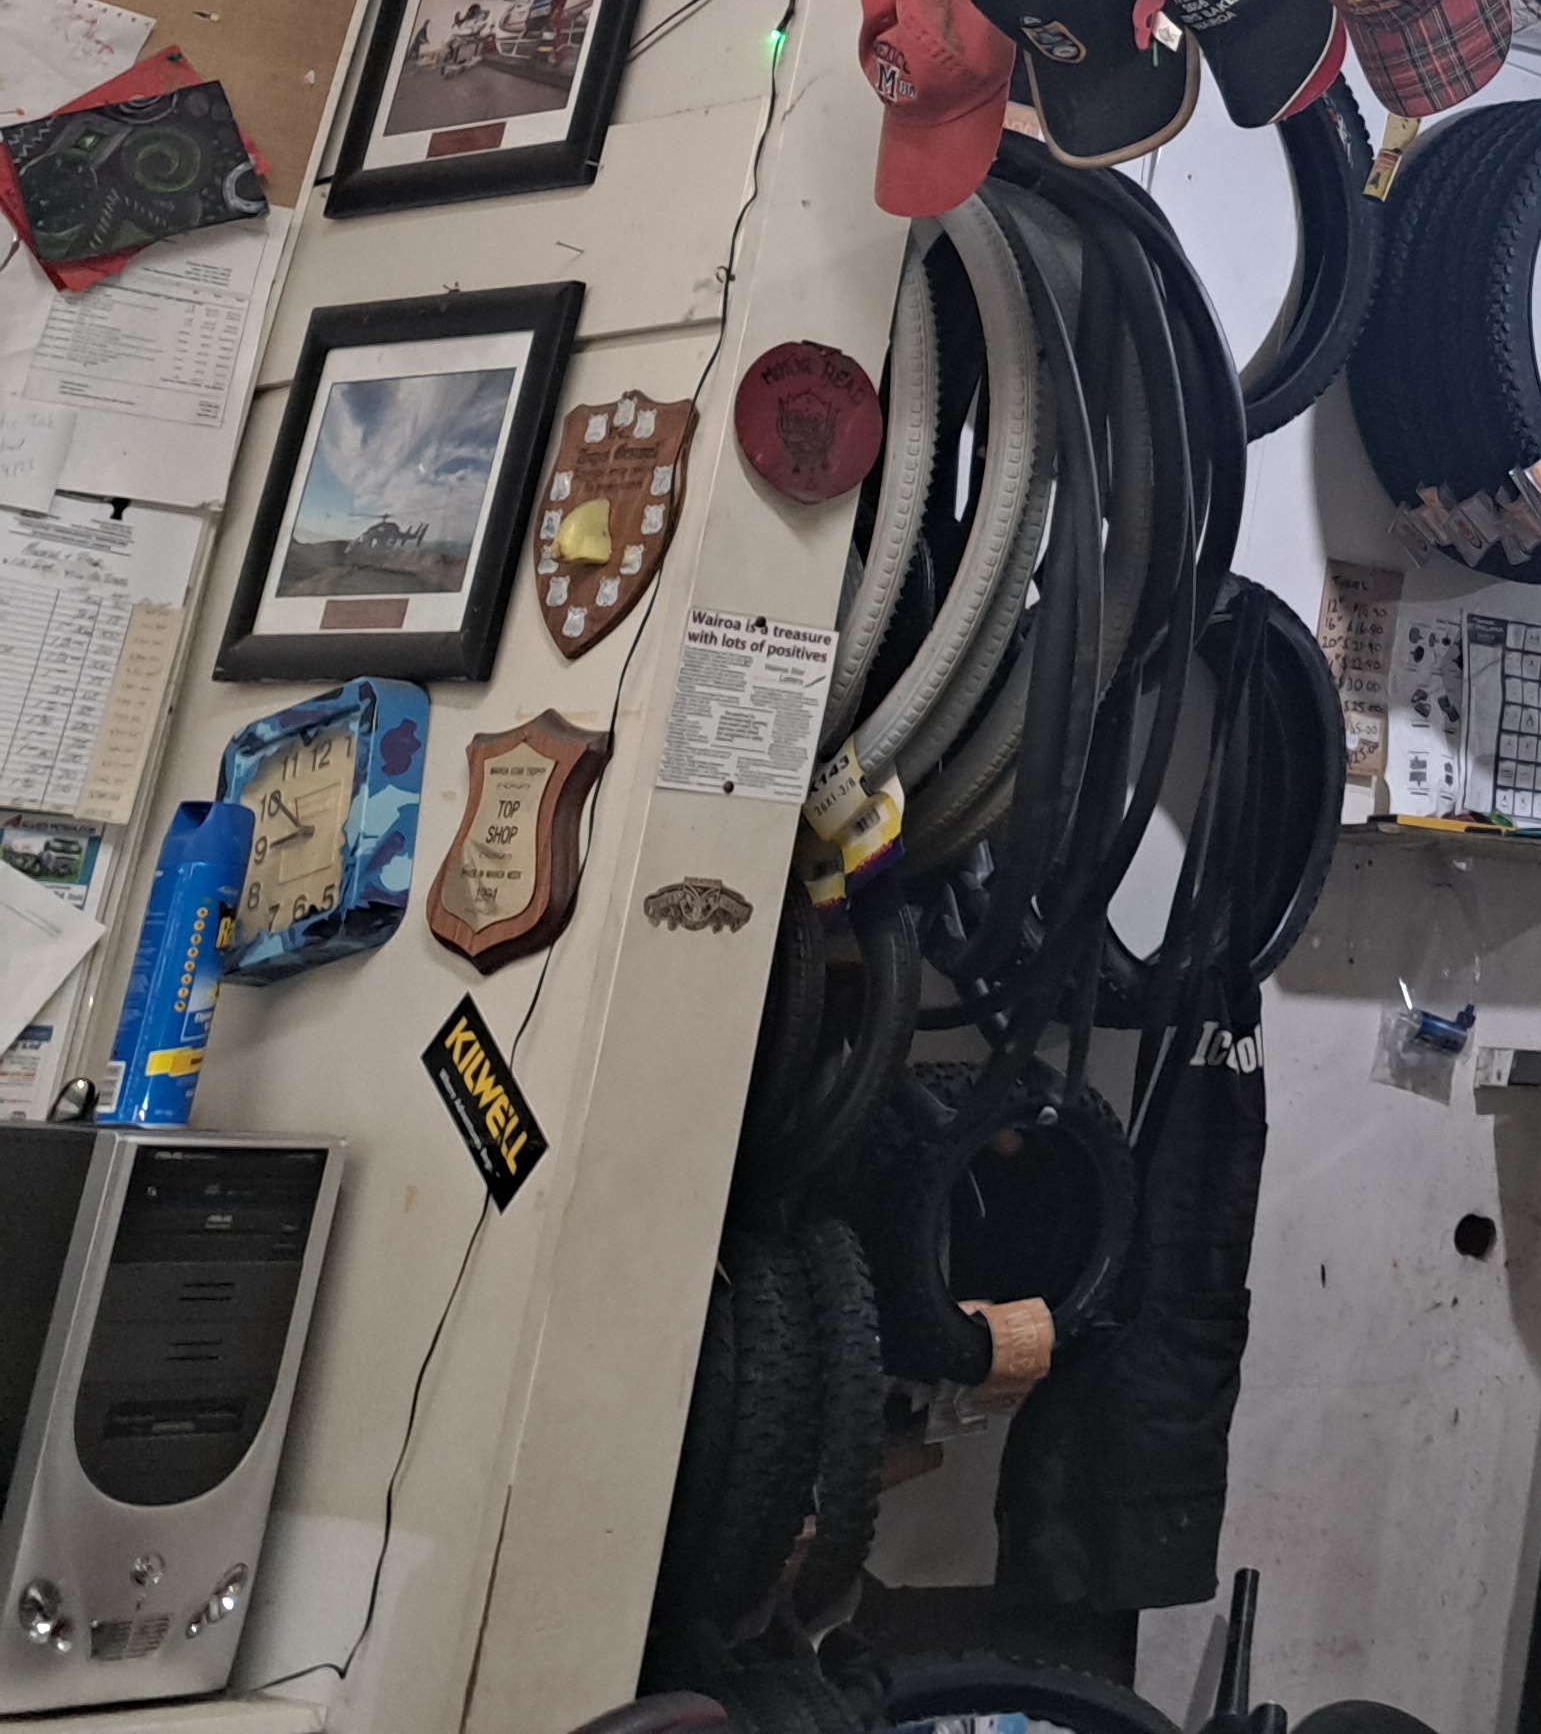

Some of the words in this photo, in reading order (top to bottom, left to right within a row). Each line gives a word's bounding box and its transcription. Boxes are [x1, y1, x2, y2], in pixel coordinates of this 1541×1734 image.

[692, 610, 741, 631] Wairoa
[773, 626, 832, 647] treasure
[687, 630, 718, 647] with
[721, 636, 746, 651] lots
[750, 640, 768, 653] of
[766, 644, 828, 664] positives
[282, 753, 299, 781] 11
[312, 739, 333, 772] 12
[260, 789, 282, 822] 10
[498, 799, 521, 818] TOP
[253, 835, 268, 865] 9
[485, 825, 519, 846] SHOP
[247, 881, 262, 909] 8
[292, 893, 308, 919] 6
[321, 883, 336, 913] 5
[267, 902, 281, 932] 7
[445, 1016, 528, 1177] KILWELL
